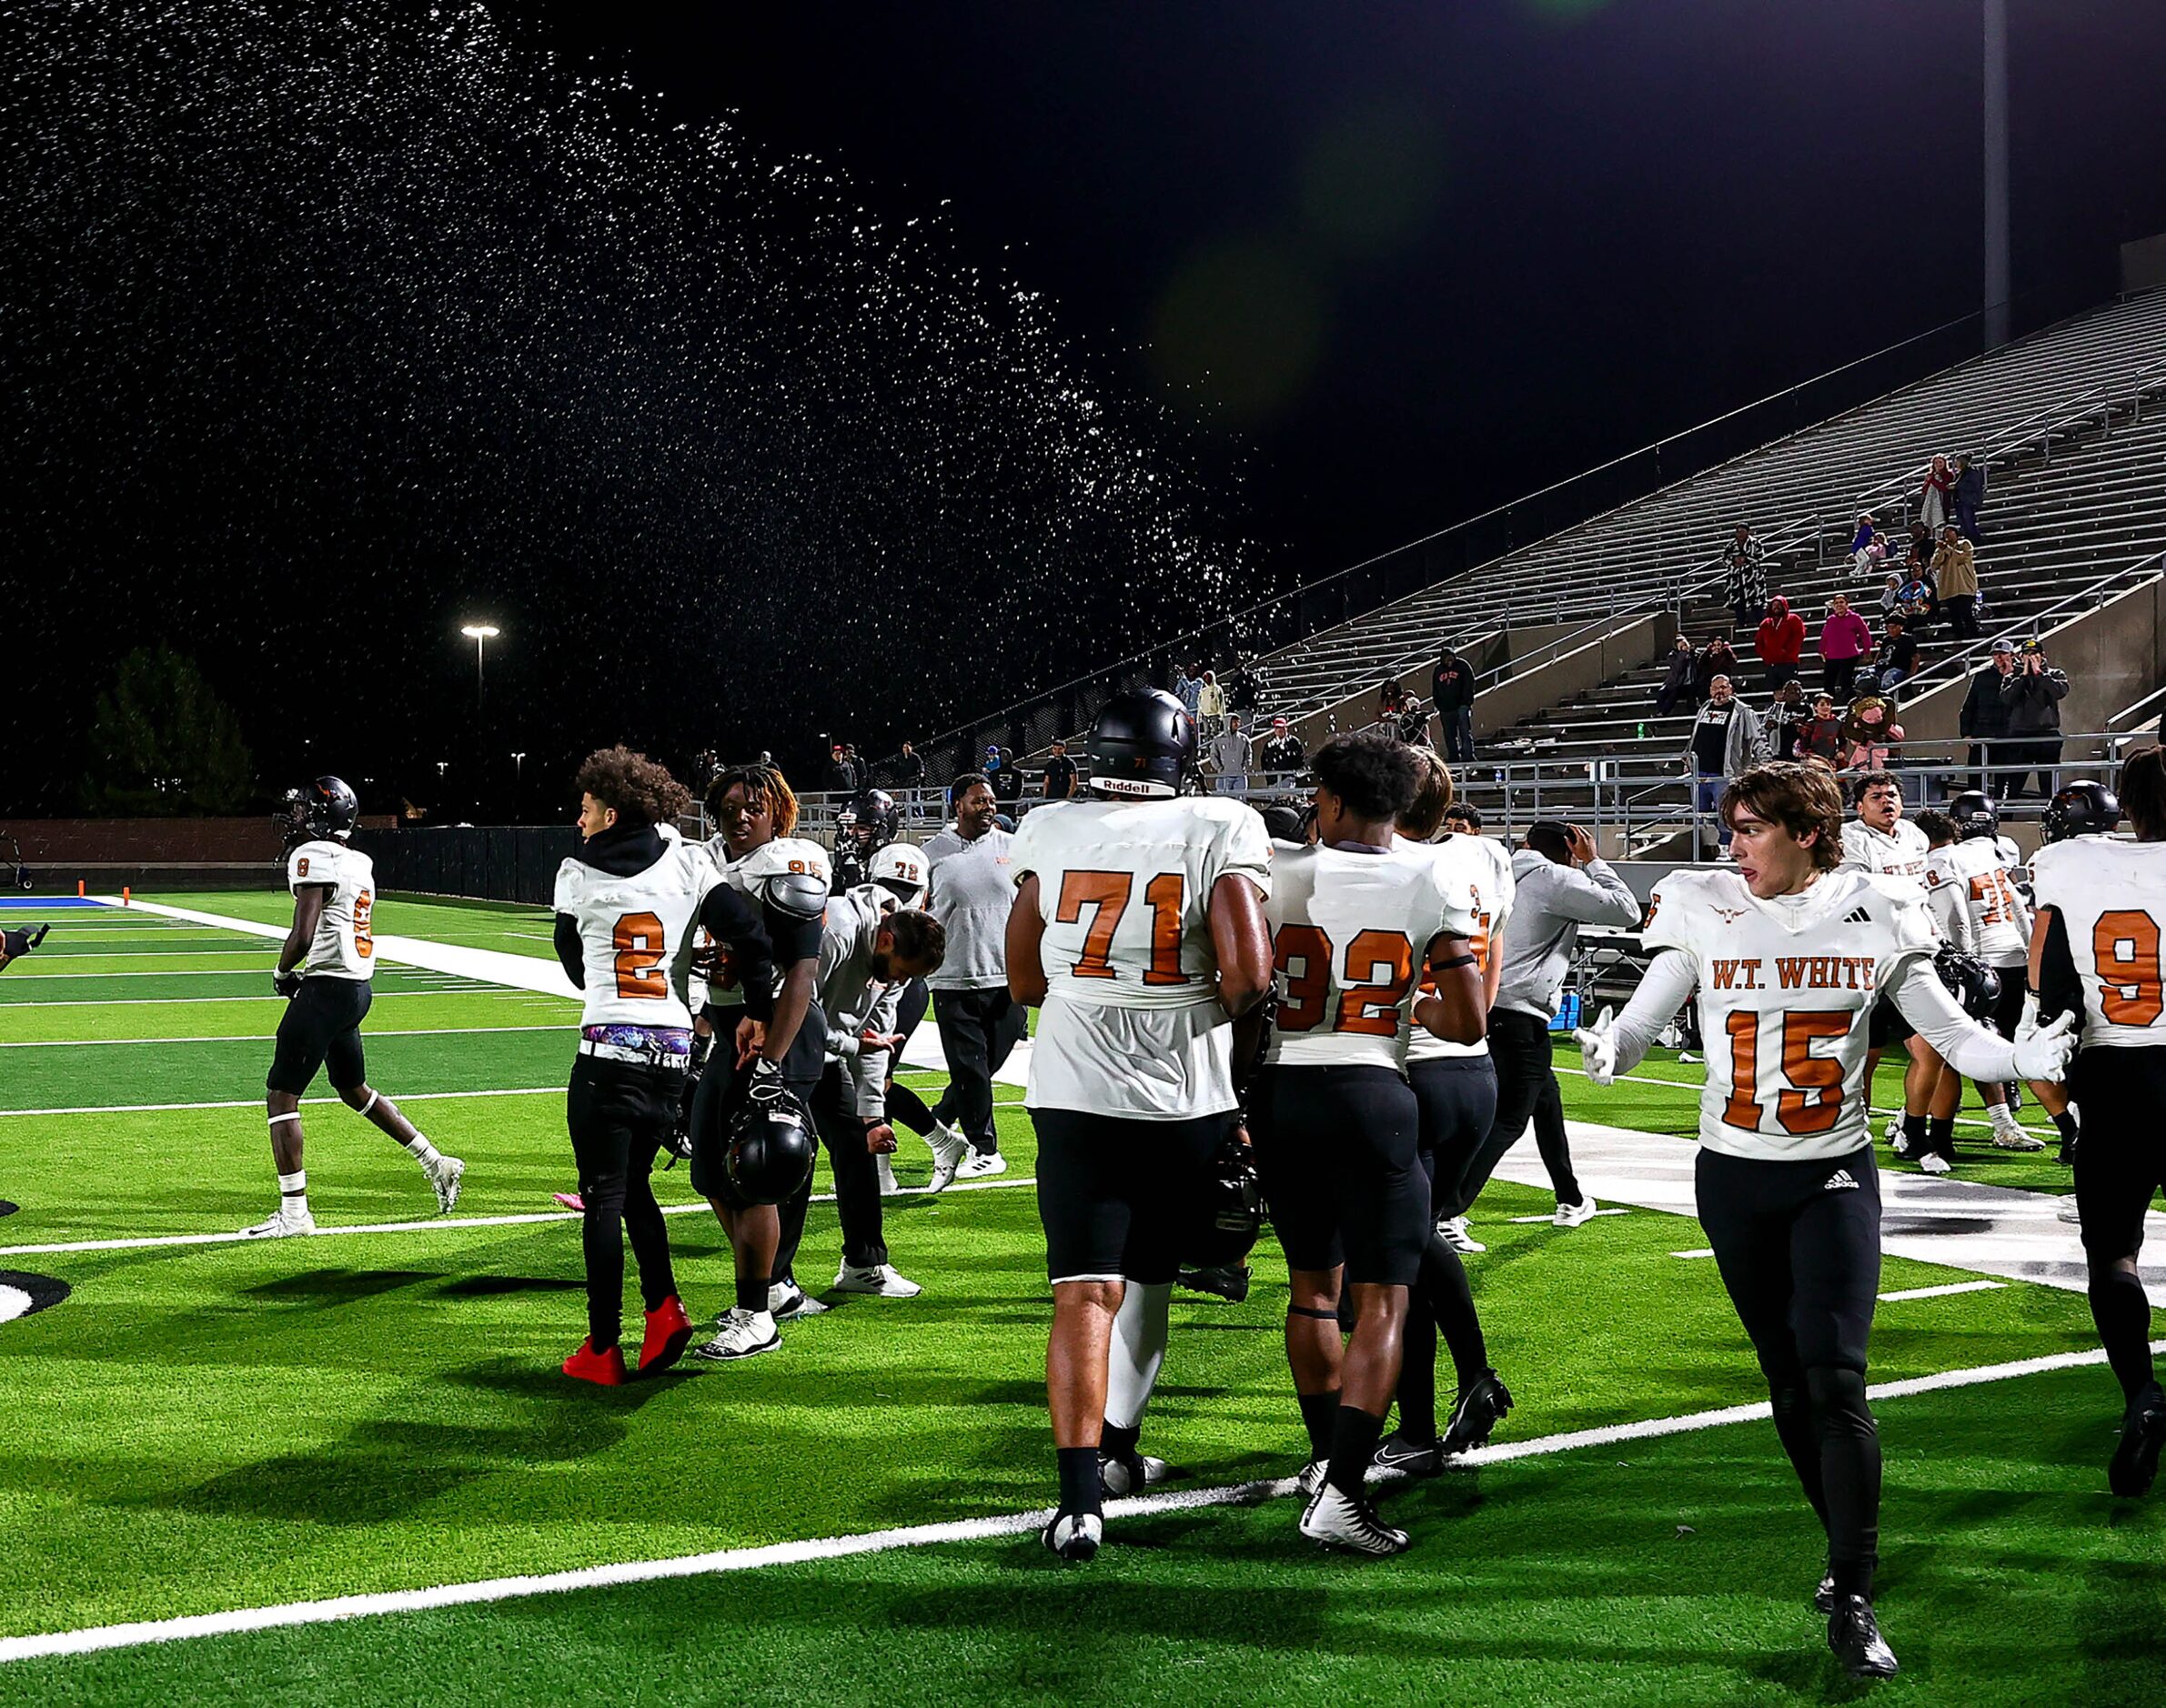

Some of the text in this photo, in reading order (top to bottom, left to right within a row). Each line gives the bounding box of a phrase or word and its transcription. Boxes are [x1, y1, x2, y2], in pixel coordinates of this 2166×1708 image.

[1103, 779, 1150, 794] Riddell
[1133, 757, 1147, 769] 71
[297, 858, 309, 877] 8
[612, 910, 669, 1000] 2
[1056, 869, 1191, 986] 71
[1273, 923, 1415, 1038] 32
[1712, 957, 1875, 990] W.T. WHITE
[2093, 909, 2161, 1027] 9
[1721, 1010, 1853, 1135] 15
[1824, 1181, 1859, 1190] adidas
